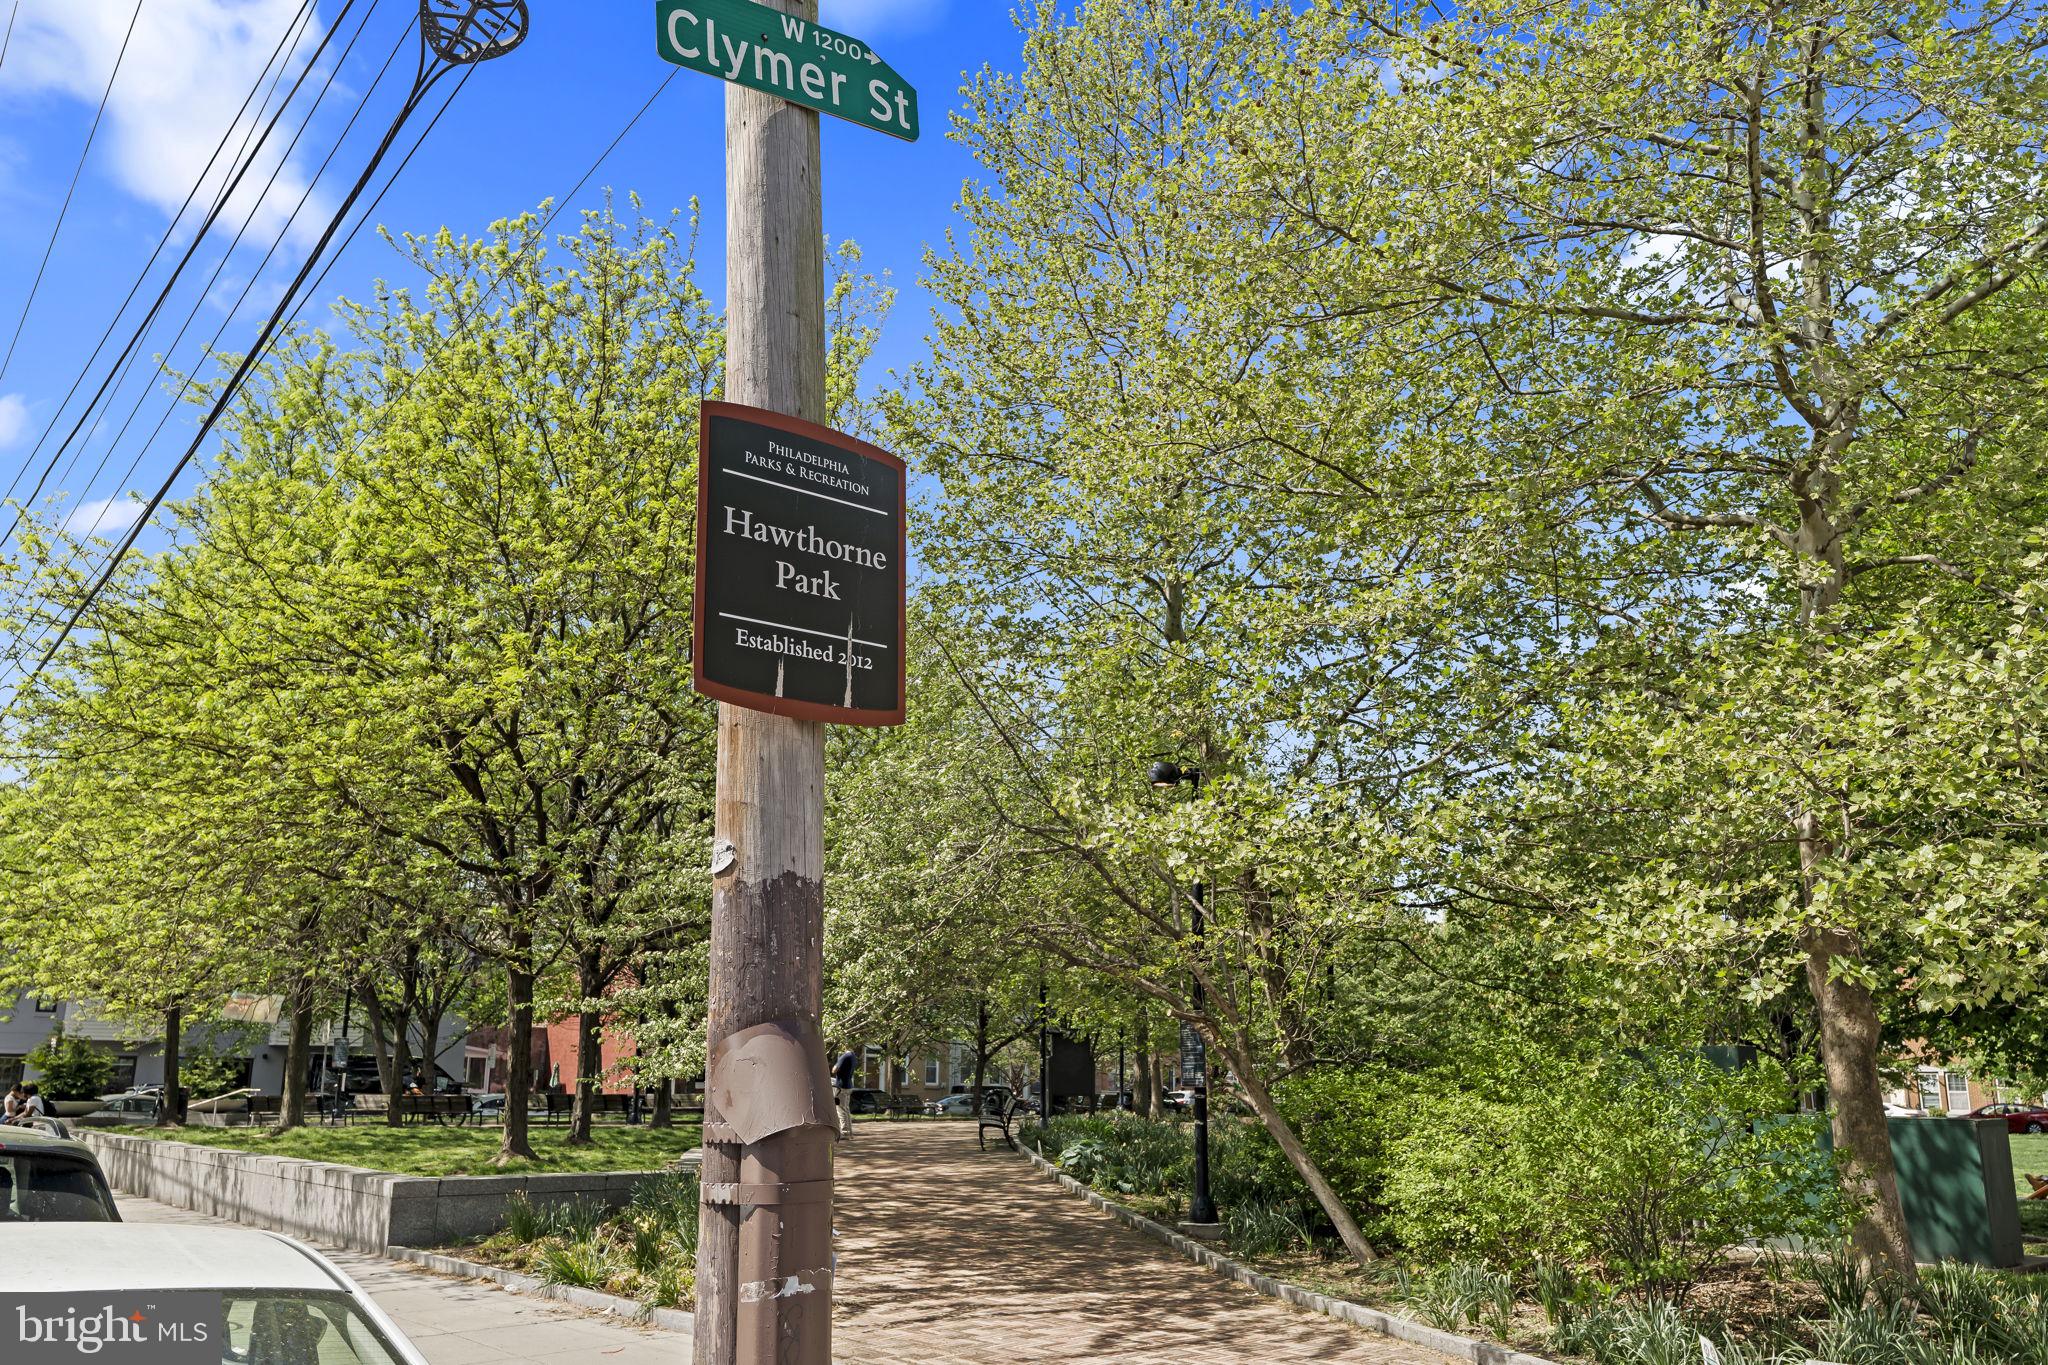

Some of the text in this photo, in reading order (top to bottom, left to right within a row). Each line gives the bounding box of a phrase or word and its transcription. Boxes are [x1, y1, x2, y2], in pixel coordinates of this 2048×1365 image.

[780, 14, 862, 60] W 1200
[667, 8, 911, 130] Clymer St
[744, 450, 869, 496] PARKS & RECREATION
[768, 440, 850, 475] PHILADELPHIA
[723, 505, 888, 570] Hawthorne
[775, 560, 841, 601] Park
[735, 628, 834, 663] Established
